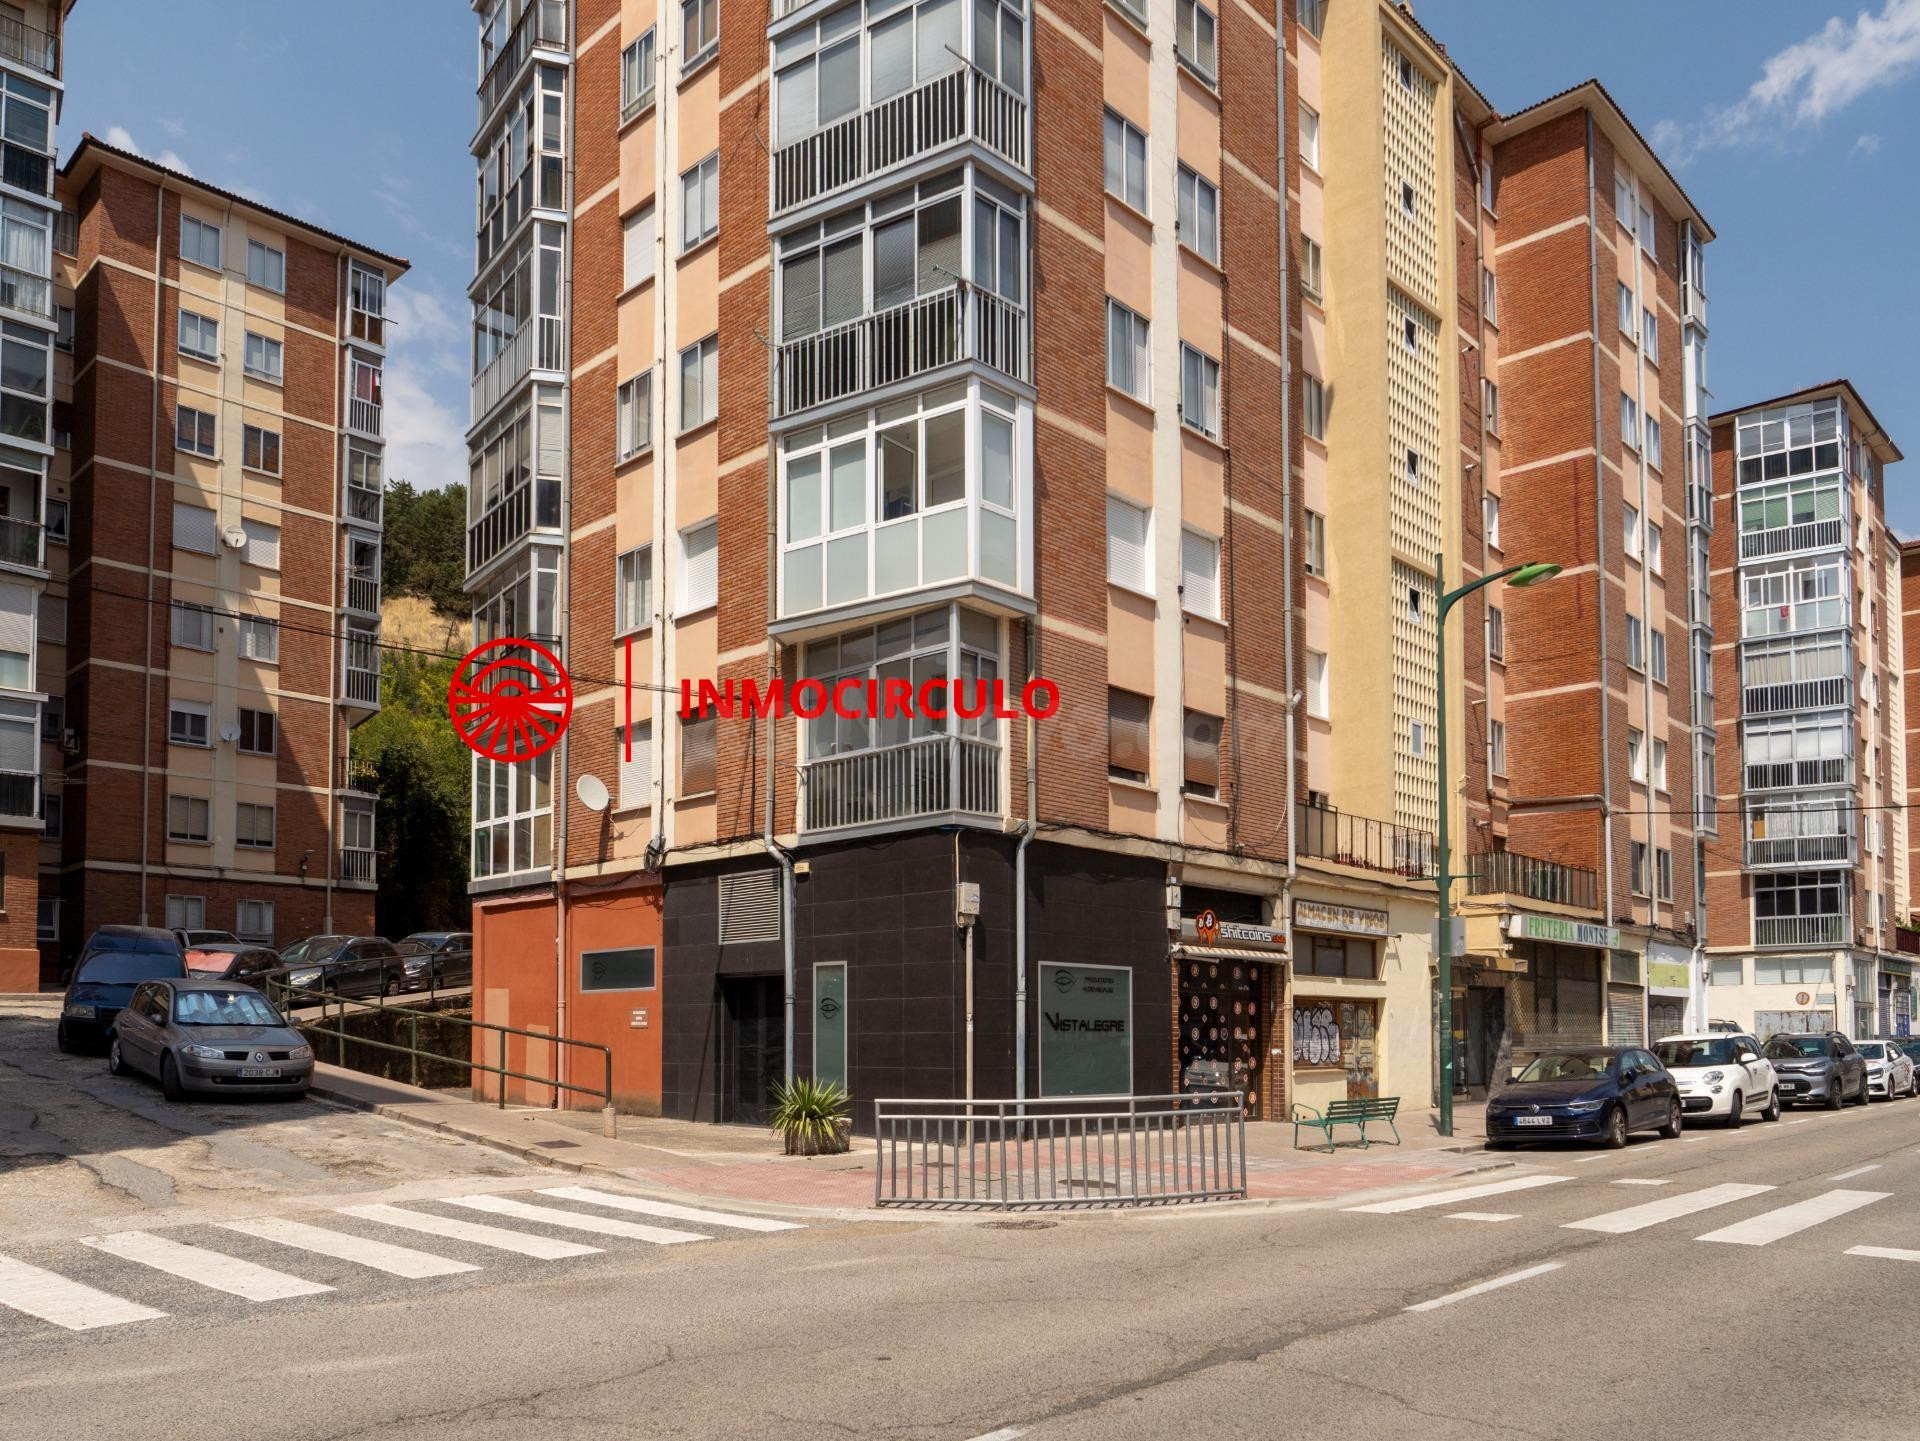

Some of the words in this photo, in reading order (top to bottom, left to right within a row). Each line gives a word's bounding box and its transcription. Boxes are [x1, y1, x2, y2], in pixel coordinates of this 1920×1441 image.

[1297, 902, 1339, 922] ALMACEN
[1342, 908, 1354, 925] DE
[1359, 911, 1385, 929] VINOS
[1220, 925, 1272, 942] shitcoins
[1528, 917, 1575, 941] FRUTERIA
[1576, 923, 1609, 945] MONTSE
[1044, 1011, 1125, 1032] VISTALEGRE
